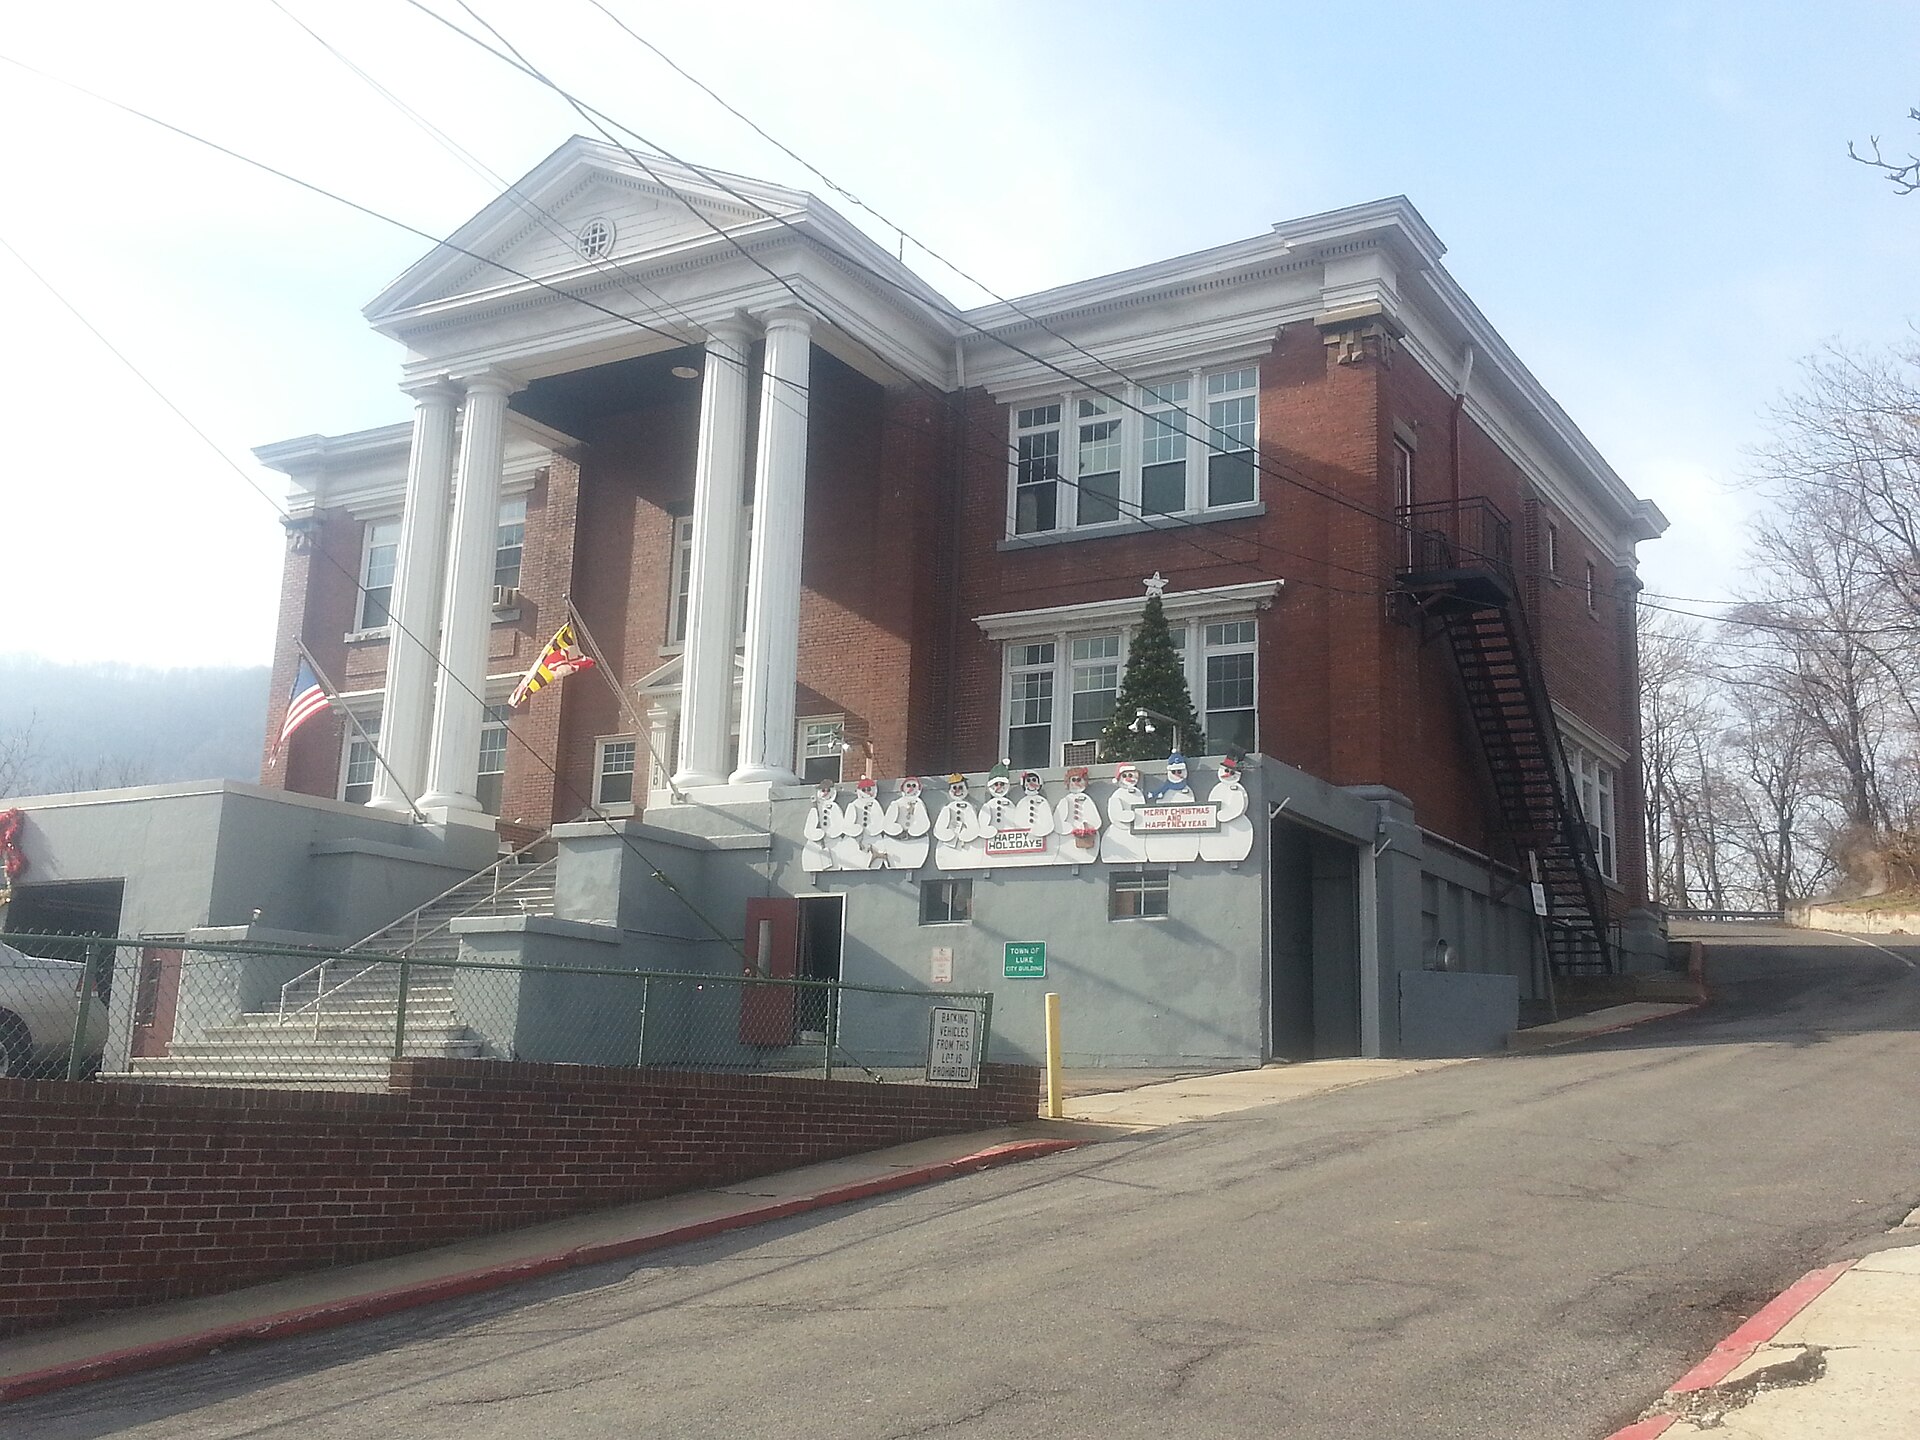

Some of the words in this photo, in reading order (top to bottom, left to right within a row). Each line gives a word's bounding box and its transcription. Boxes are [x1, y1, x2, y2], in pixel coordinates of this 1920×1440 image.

[1143, 808, 1168, 816] MERRY
[1170, 807, 1209, 816] CHRISTMAS
[1171, 820, 1187, 828] NEW
[994, 832, 1029, 842] HAPPY
[989, 839, 1042, 850] HOLIDAYS
[1010, 947, 1029, 955] TOWN
[1015, 956, 1034, 964] LUKE
[941, 1012, 968, 1024] BACKING
[940, 1026, 969, 1038] VEHICLES
[936, 1039, 954, 1050] FROM
[956, 1040, 970, 1051] THIS
[941, 1053, 954, 1064] LOT
[956, 1053, 963, 1064] IS
[932, 1066, 969, 1078] PROHIBITED
